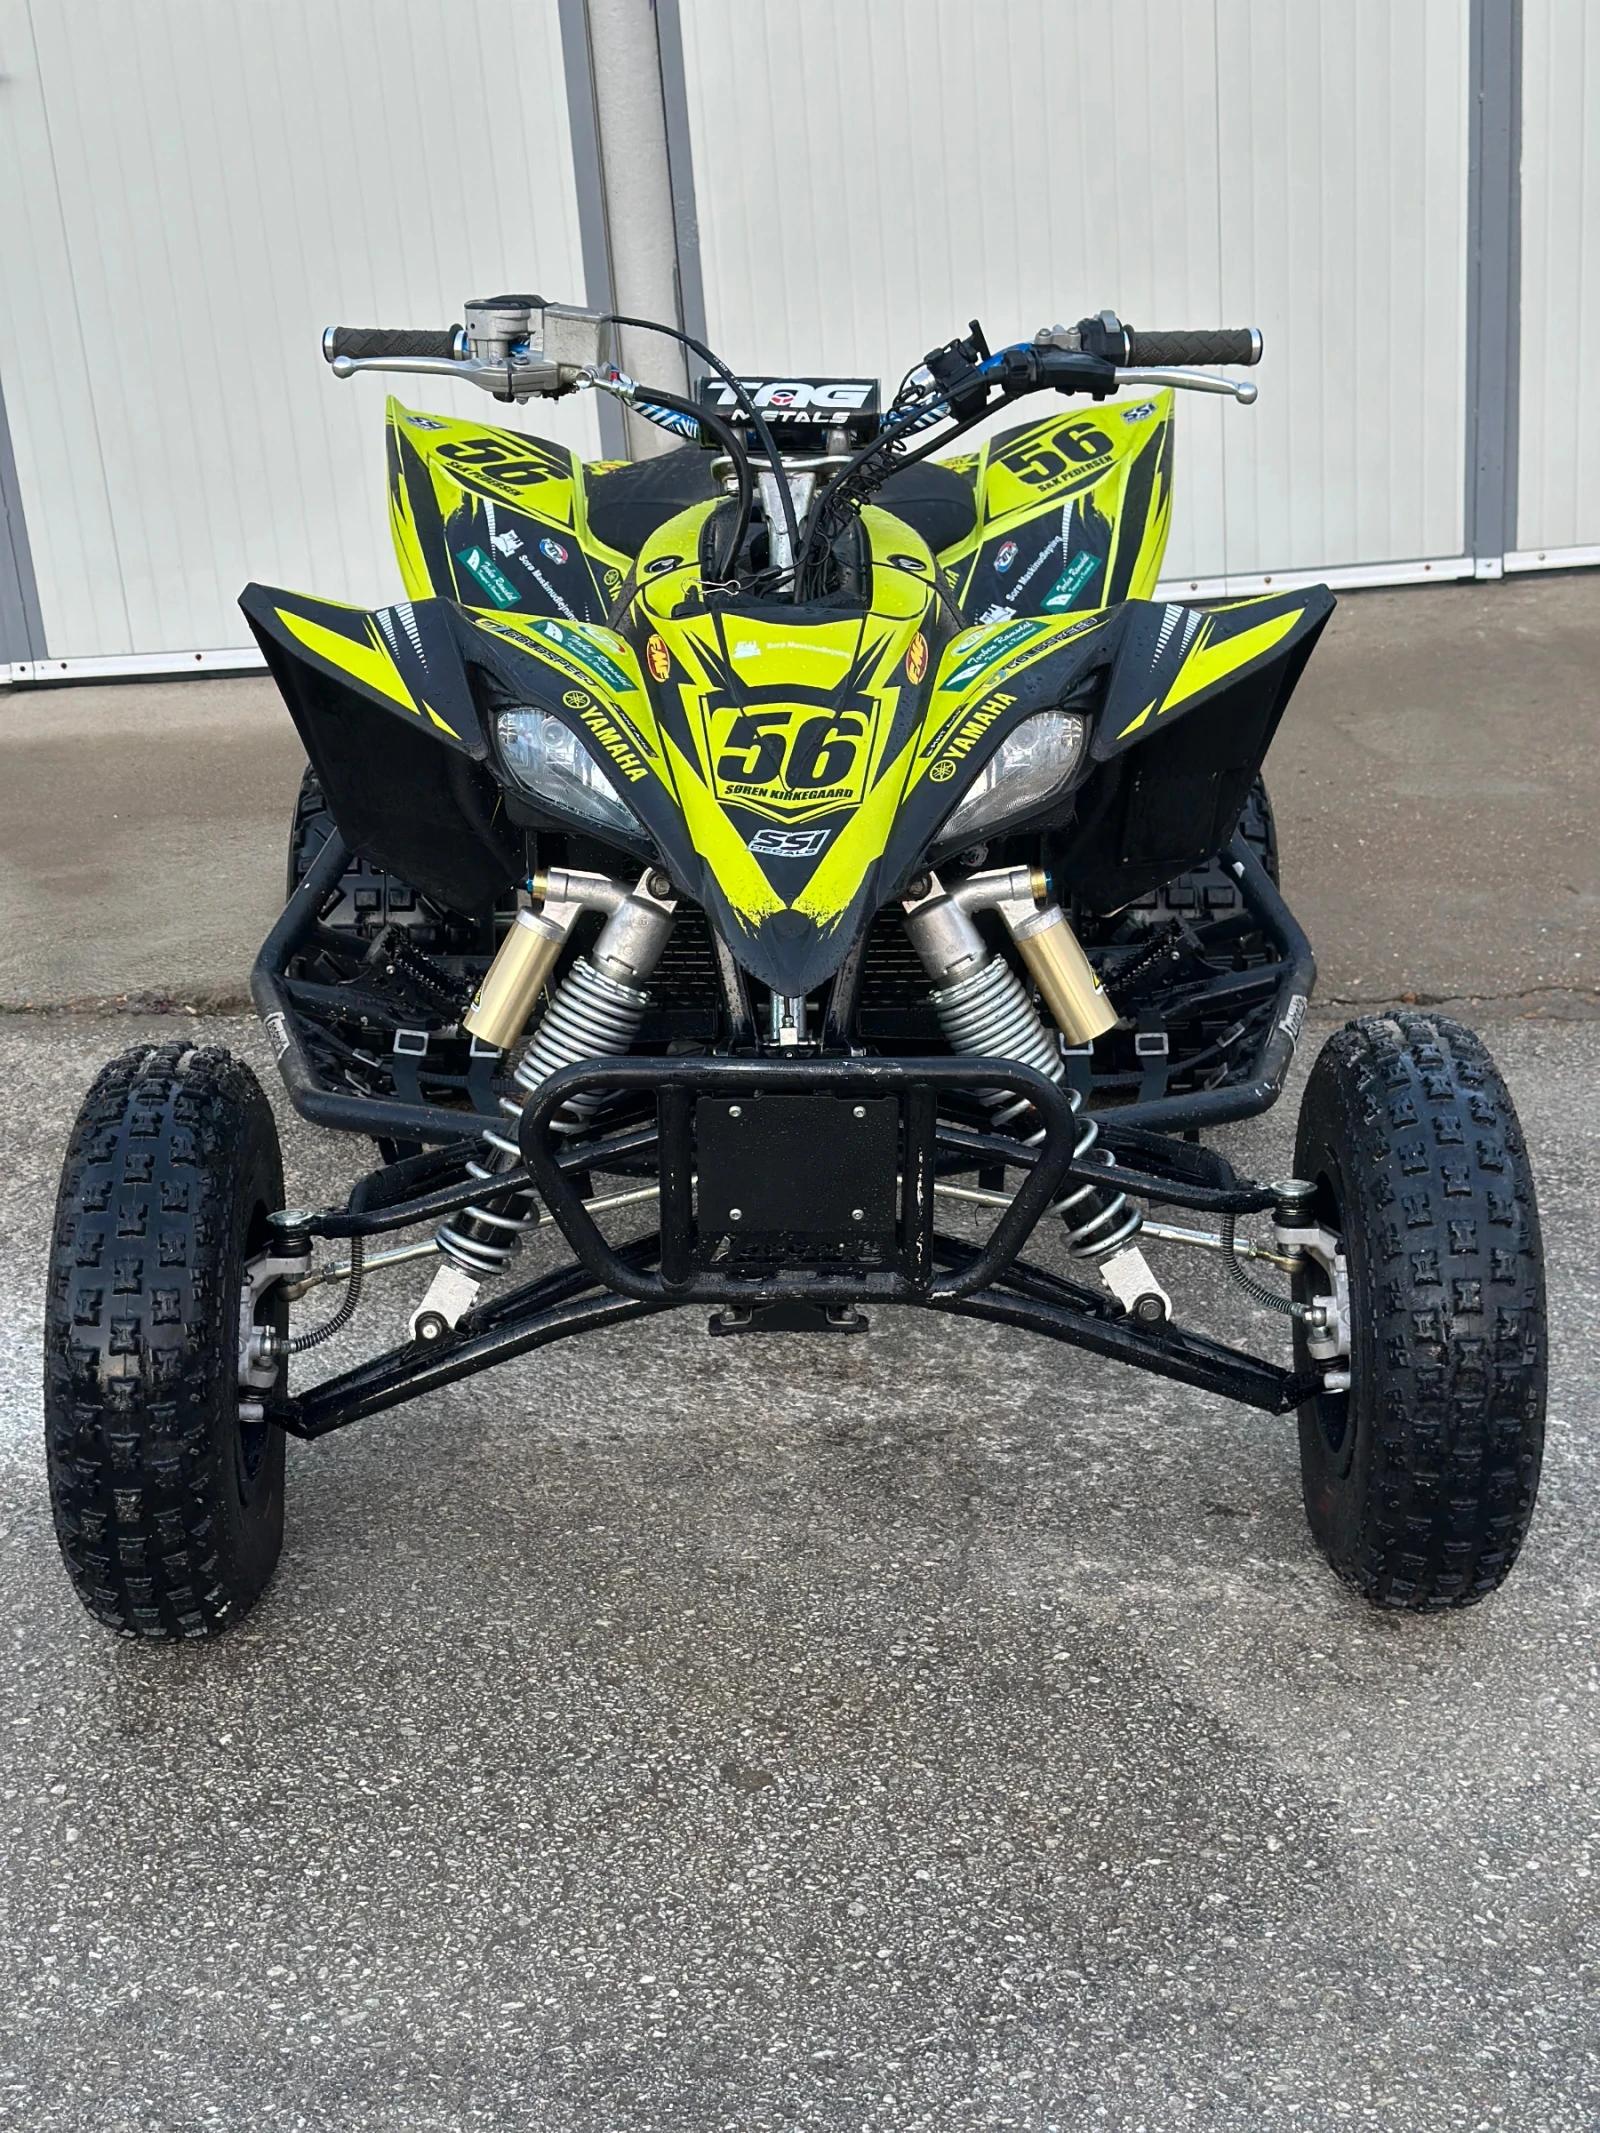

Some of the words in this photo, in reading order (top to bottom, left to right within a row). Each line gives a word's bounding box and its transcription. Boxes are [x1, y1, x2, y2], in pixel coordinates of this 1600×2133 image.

[707, 382, 873, 408] TAG
[731, 409, 851, 424] METALS
[435, 438, 570, 486] 56
[1000, 422, 1114, 485] 56
[1037, 479, 1062, 492] S&K
[1060, 455, 1113, 481] PEDERSEN
[468, 470, 524, 496] PEDERSEN
[648, 634, 670, 682] FMF
[906, 633, 927, 685] FMF
[966, 643, 998, 665] Torben
[580, 705, 649, 783] YAMAHA
[943, 692, 1018, 759] YAMAHA
[716, 710, 863, 789] 56
[725, 784, 768, 798] SØREN
[769, 788, 853, 801] KIRKEGAARD
[753, 830, 826, 851] SSI
